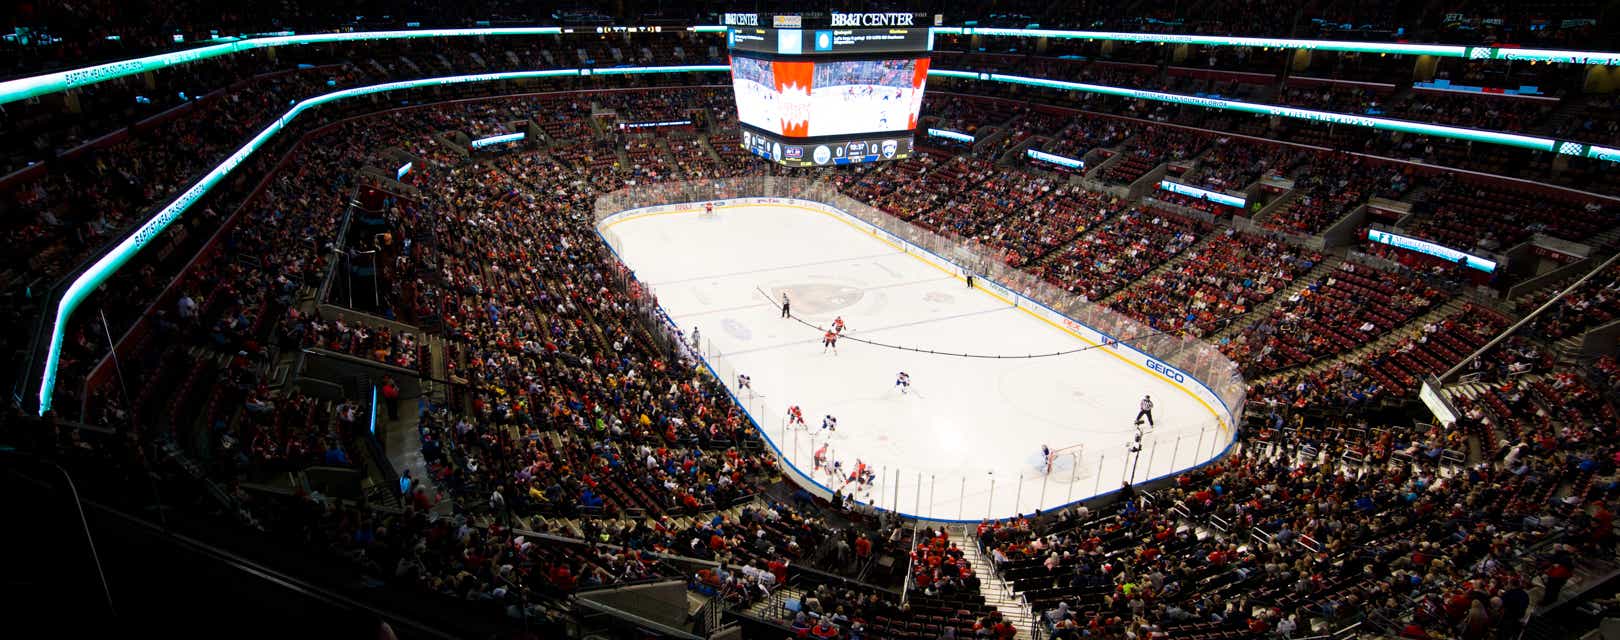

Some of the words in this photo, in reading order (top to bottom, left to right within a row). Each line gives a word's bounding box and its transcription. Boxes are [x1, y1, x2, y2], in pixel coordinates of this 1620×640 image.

[737, 14, 758, 26] CENTER
[832, 13, 863, 26] BB&T
[862, 13, 914, 26] CENTER
[1315, 112, 1332, 121] THE
[1362, 118, 1375, 126] GO
[836, 146, 842, 156] 0
[872, 144, 878, 154] 0
[135, 221, 156, 247] BAPTIST
[1146, 359, 1184, 384] GEICO
